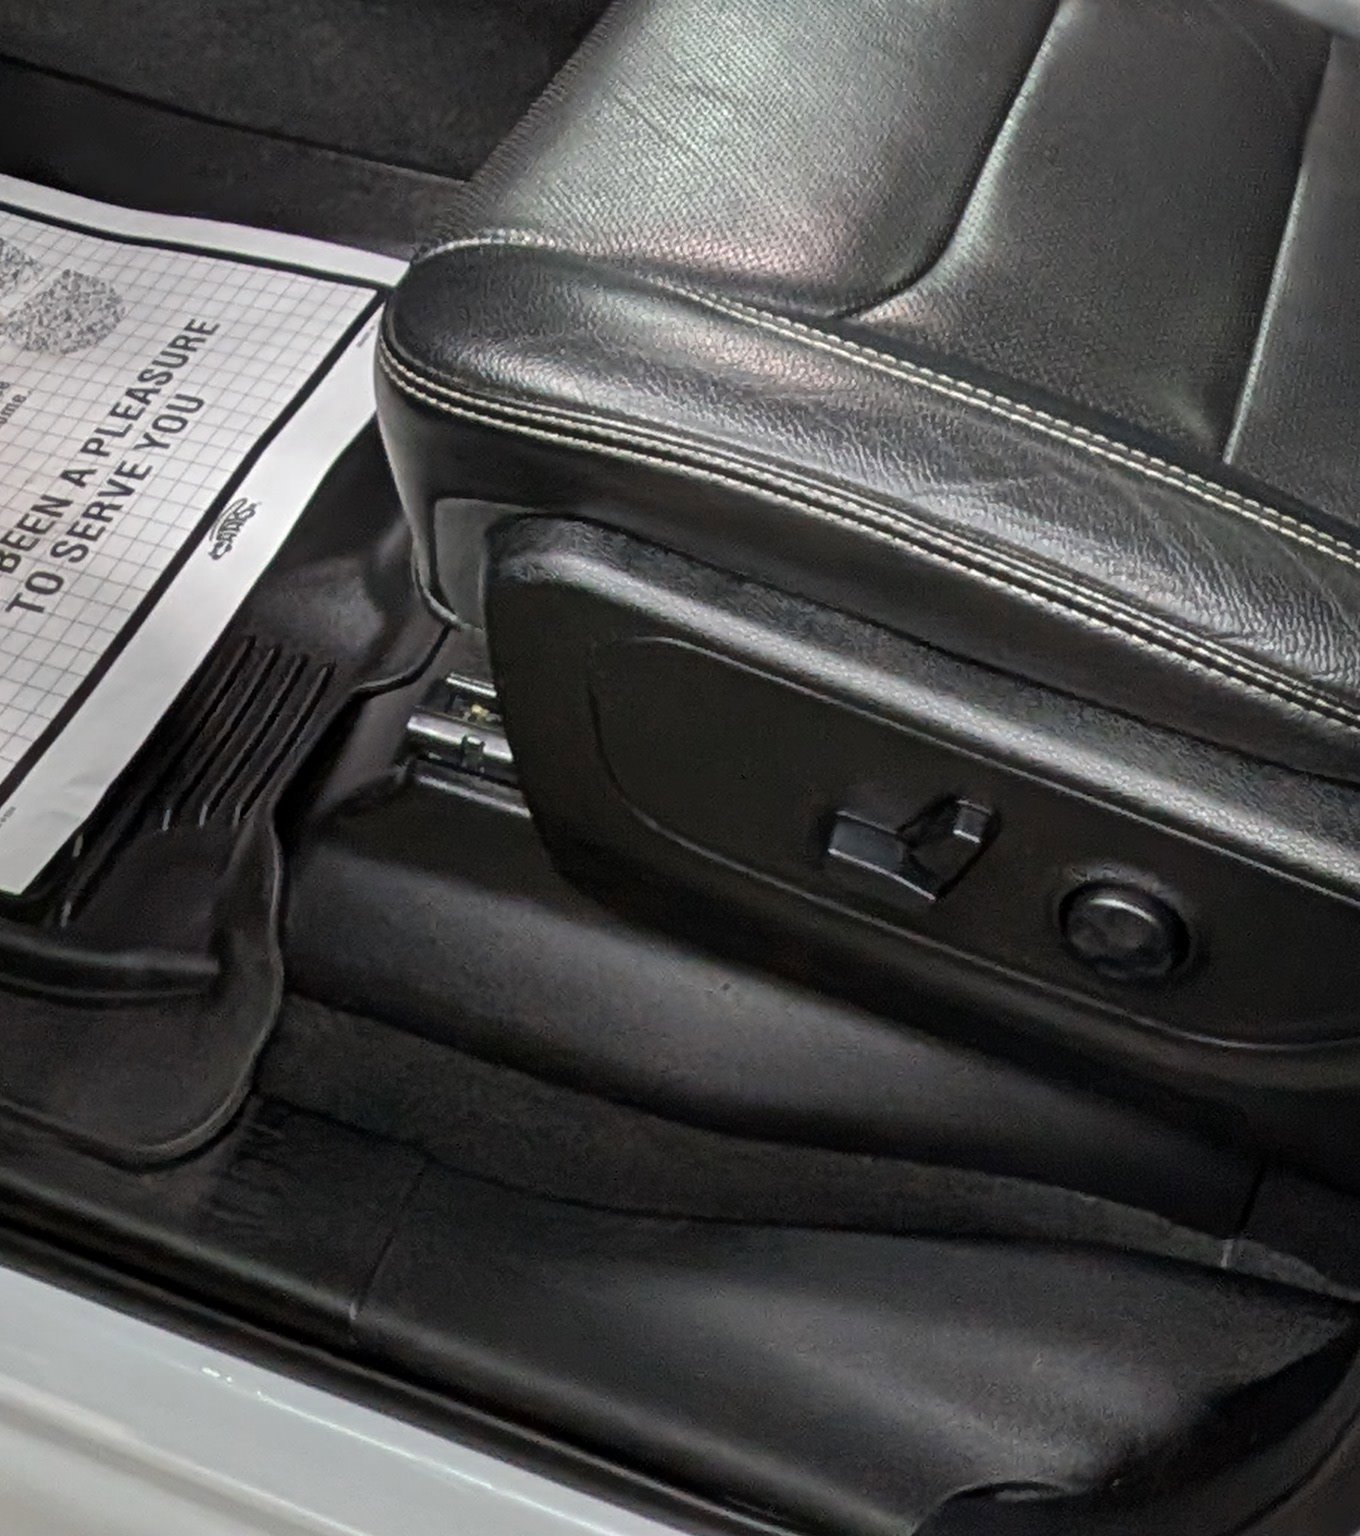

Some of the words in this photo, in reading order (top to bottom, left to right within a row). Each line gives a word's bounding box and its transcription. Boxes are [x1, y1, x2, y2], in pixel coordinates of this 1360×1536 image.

[60, 468, 97, 488] A
[80, 318, 221, 457] PLEASURE
[5, 570, 65, 614] TO
[50, 461, 153, 563] SERVE
[133, 394, 205, 451] YOU
